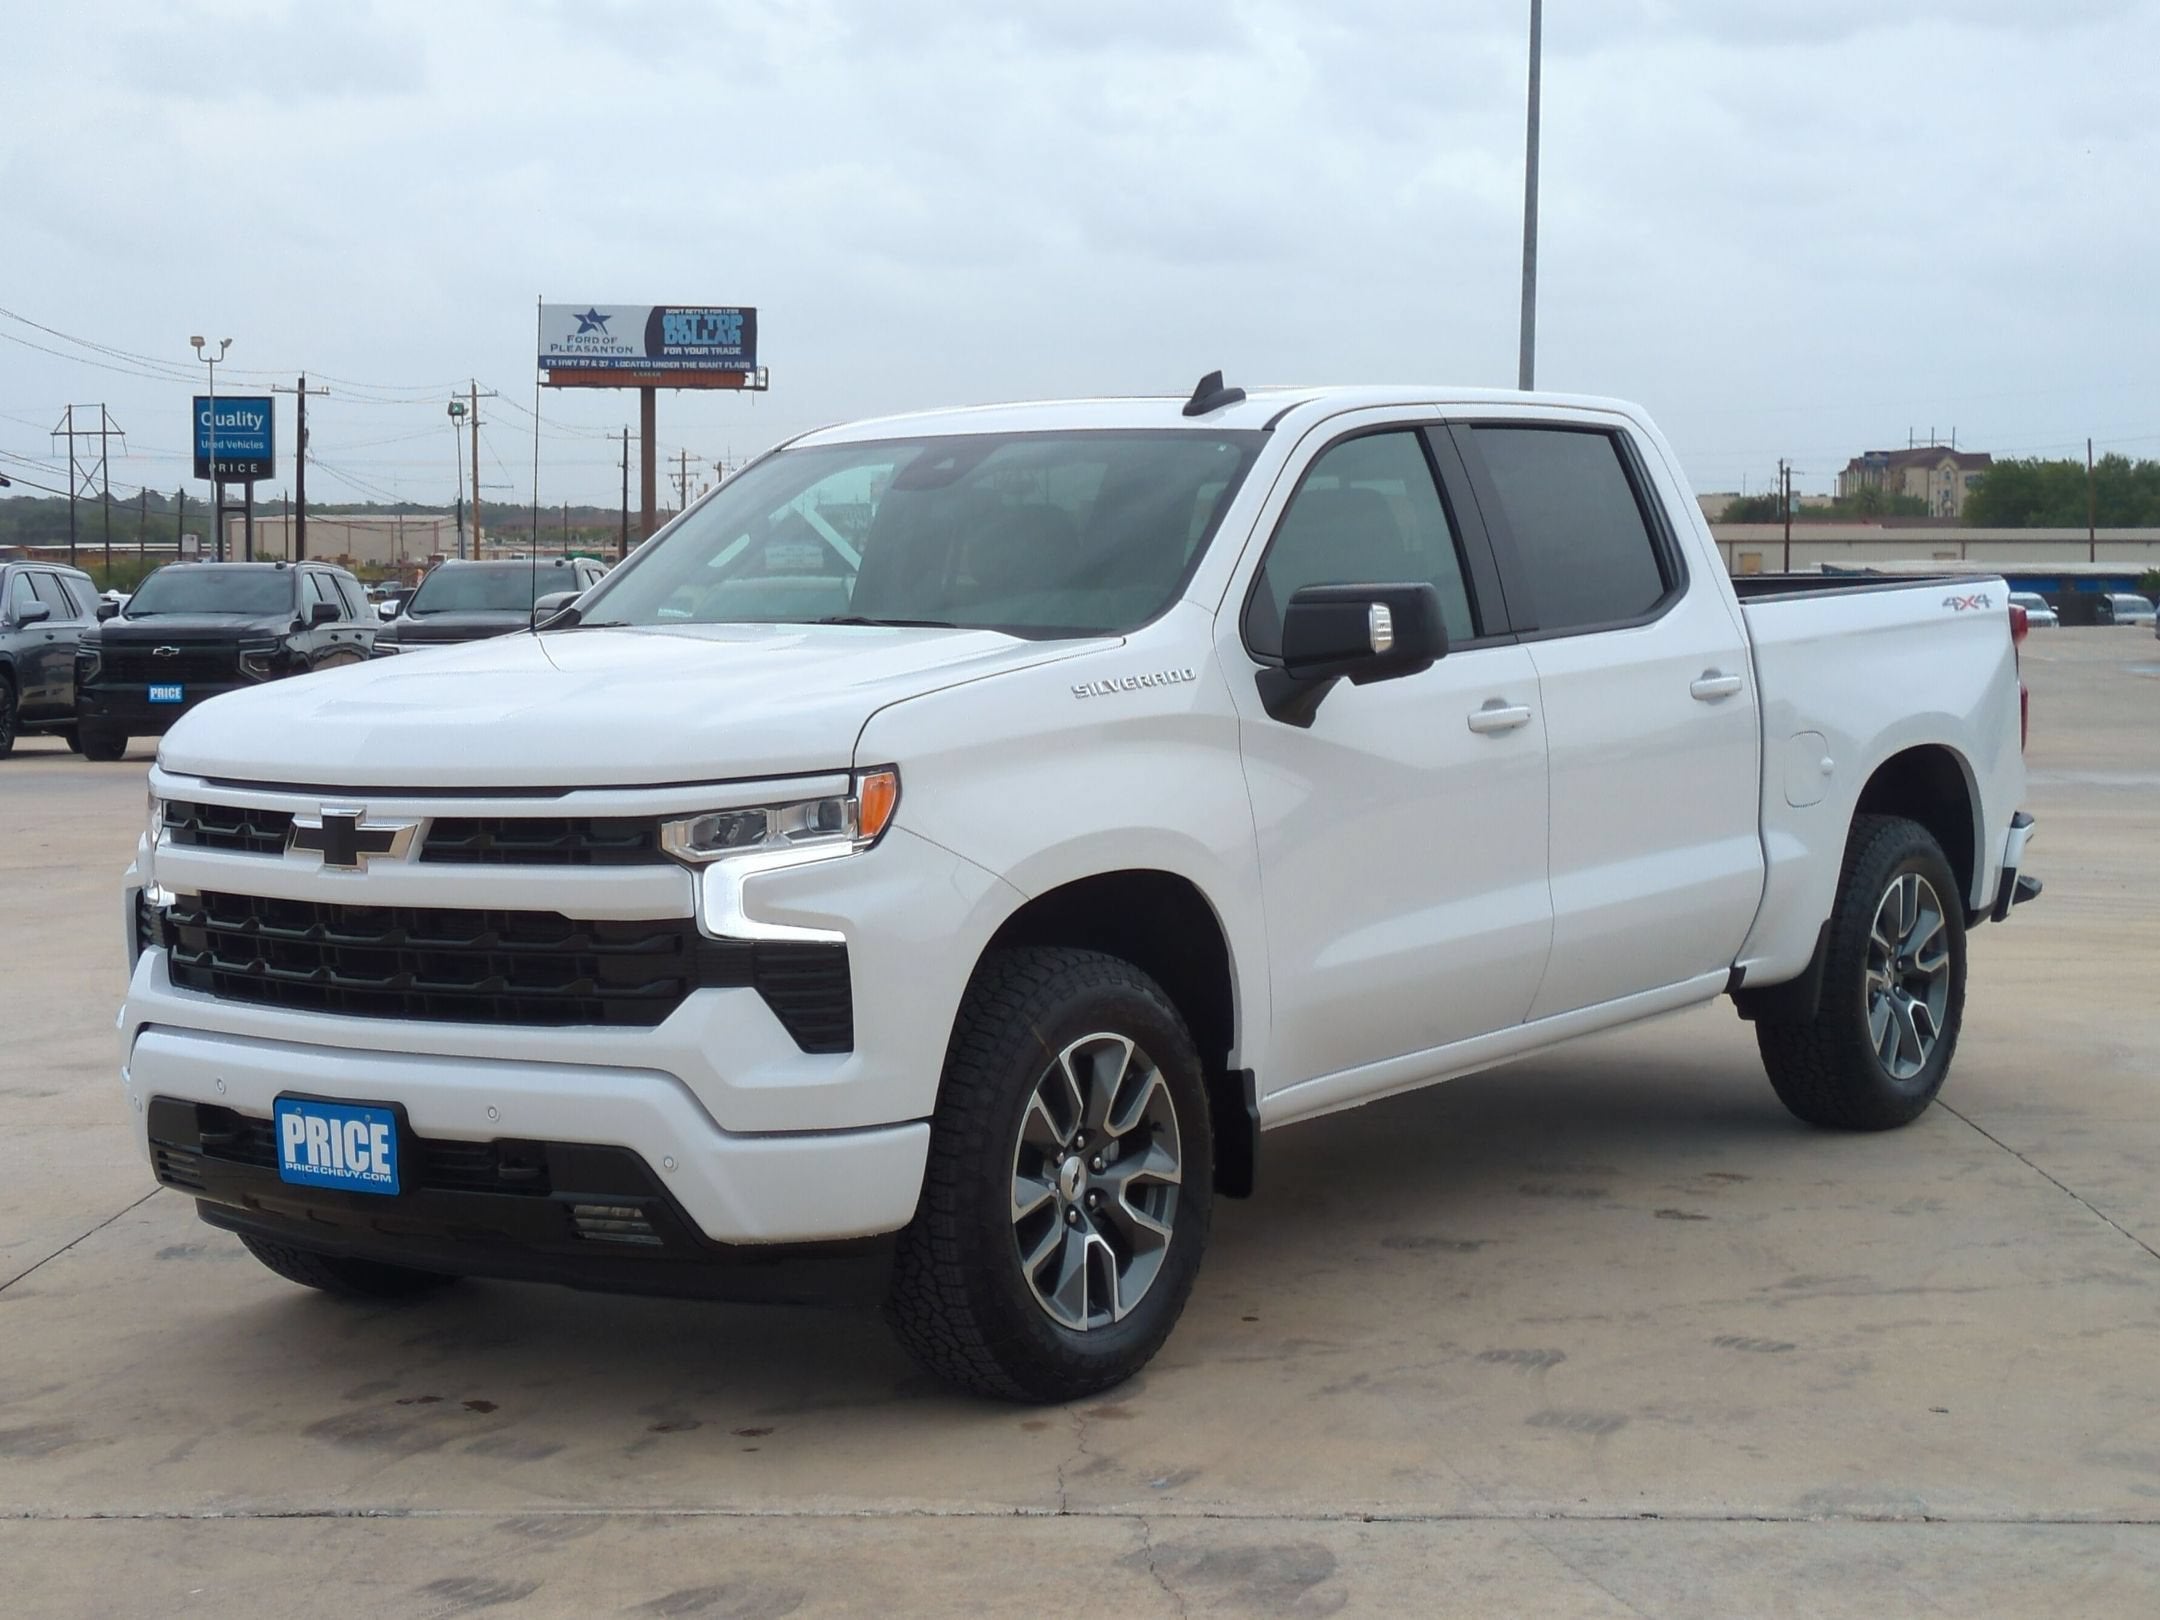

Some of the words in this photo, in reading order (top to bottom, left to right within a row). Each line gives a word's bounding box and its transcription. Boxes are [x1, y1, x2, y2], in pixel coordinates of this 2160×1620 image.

[704, 314, 743, 331] TOP
[567, 335, 600, 344] FORD
[602, 336, 618, 345] OF
[664, 329, 741, 345] DOLLAR
[550, 343, 633, 354] PLEASANTON
[663, 346, 682, 355] FOR
[684, 346, 709, 356] YOUR
[710, 347, 741, 355] TRADE
[558, 359, 578, 367] HWY
[652, 361, 680, 369] UNDER
[682, 361, 697, 369] THE
[201, 411, 264, 431] Quality
[201, 440, 224, 449] Ued
[226, 440, 264, 449] Vehicles
[1071, 667, 1197, 700] SILVERADO
[150, 687, 182, 700] PRICE
[281, 1113, 391, 1175] PRICE
[285, 1162, 392, 1183] PRICECHEVY.COM
